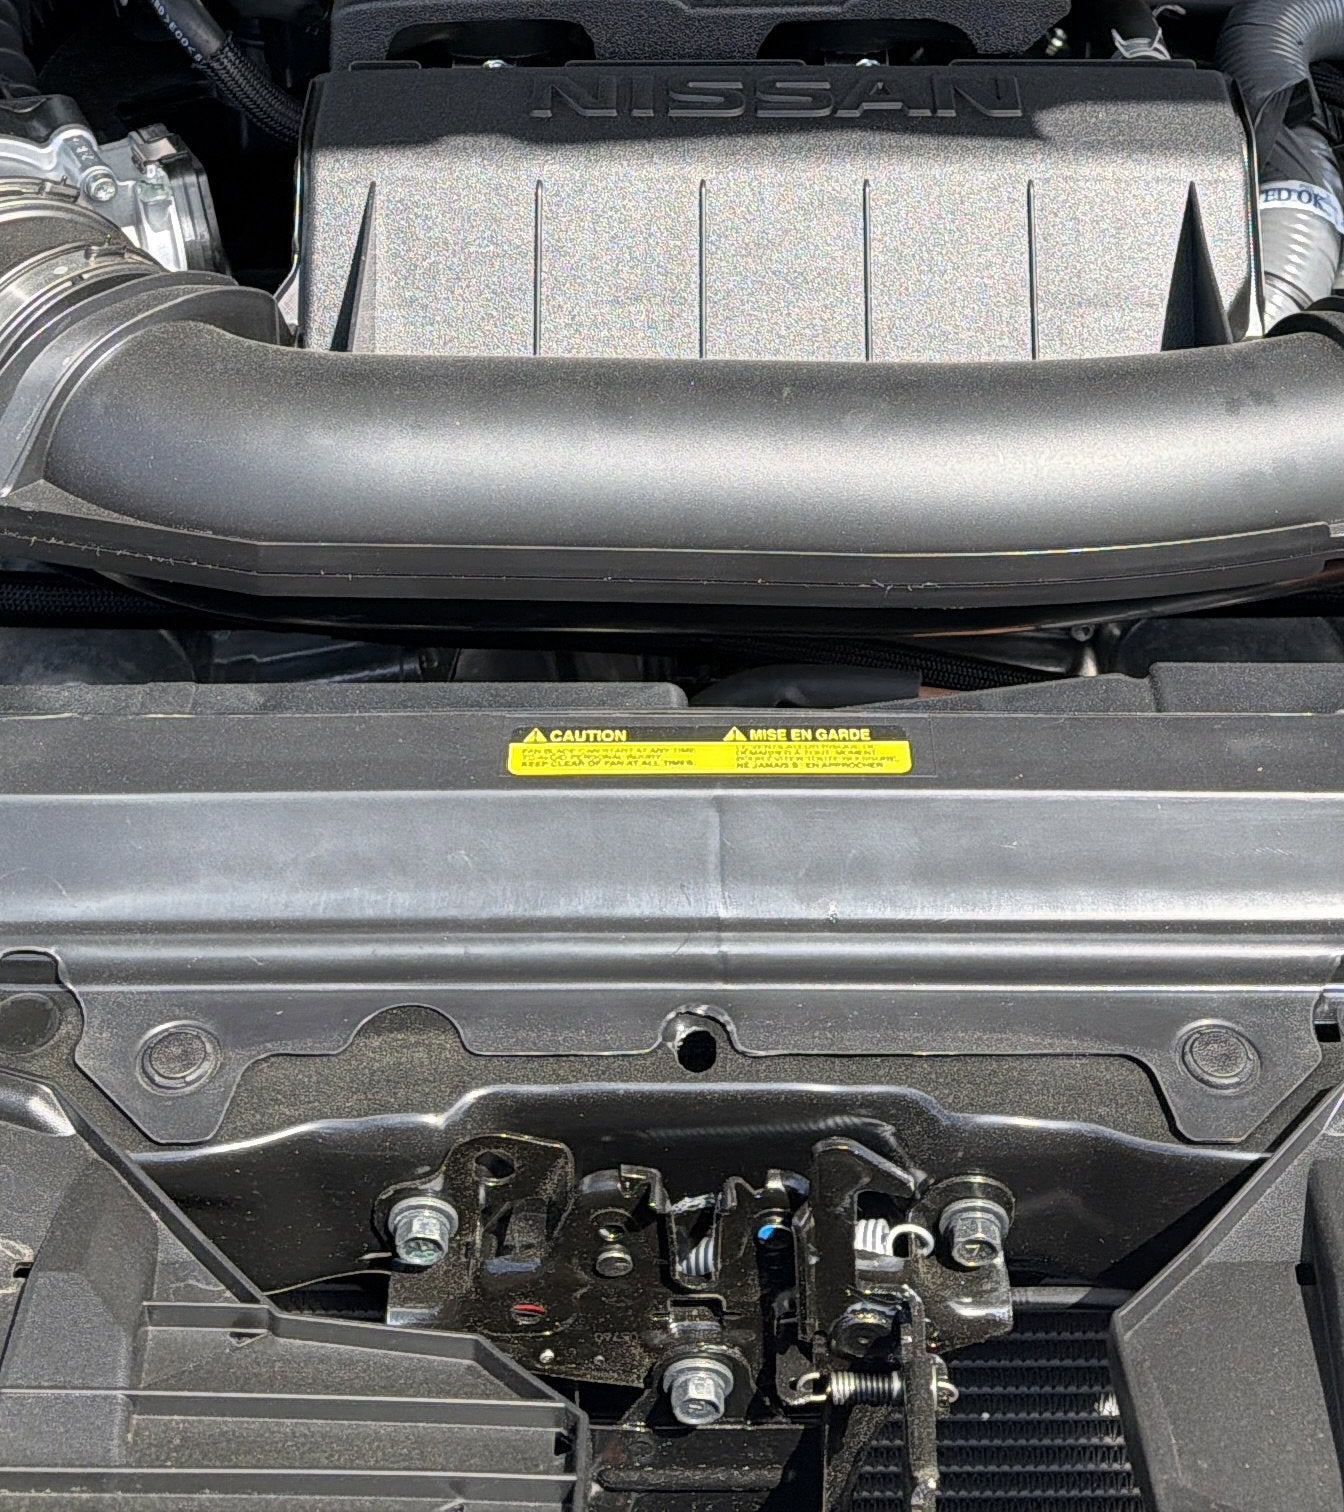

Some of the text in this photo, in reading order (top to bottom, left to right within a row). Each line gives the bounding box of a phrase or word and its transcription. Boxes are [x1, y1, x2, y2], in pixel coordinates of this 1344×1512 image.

[530, 75, 1022, 117] NISSAN
[549, 729, 627, 742] CAUTION
[749, 728, 872, 741] MISE EN GARDE
